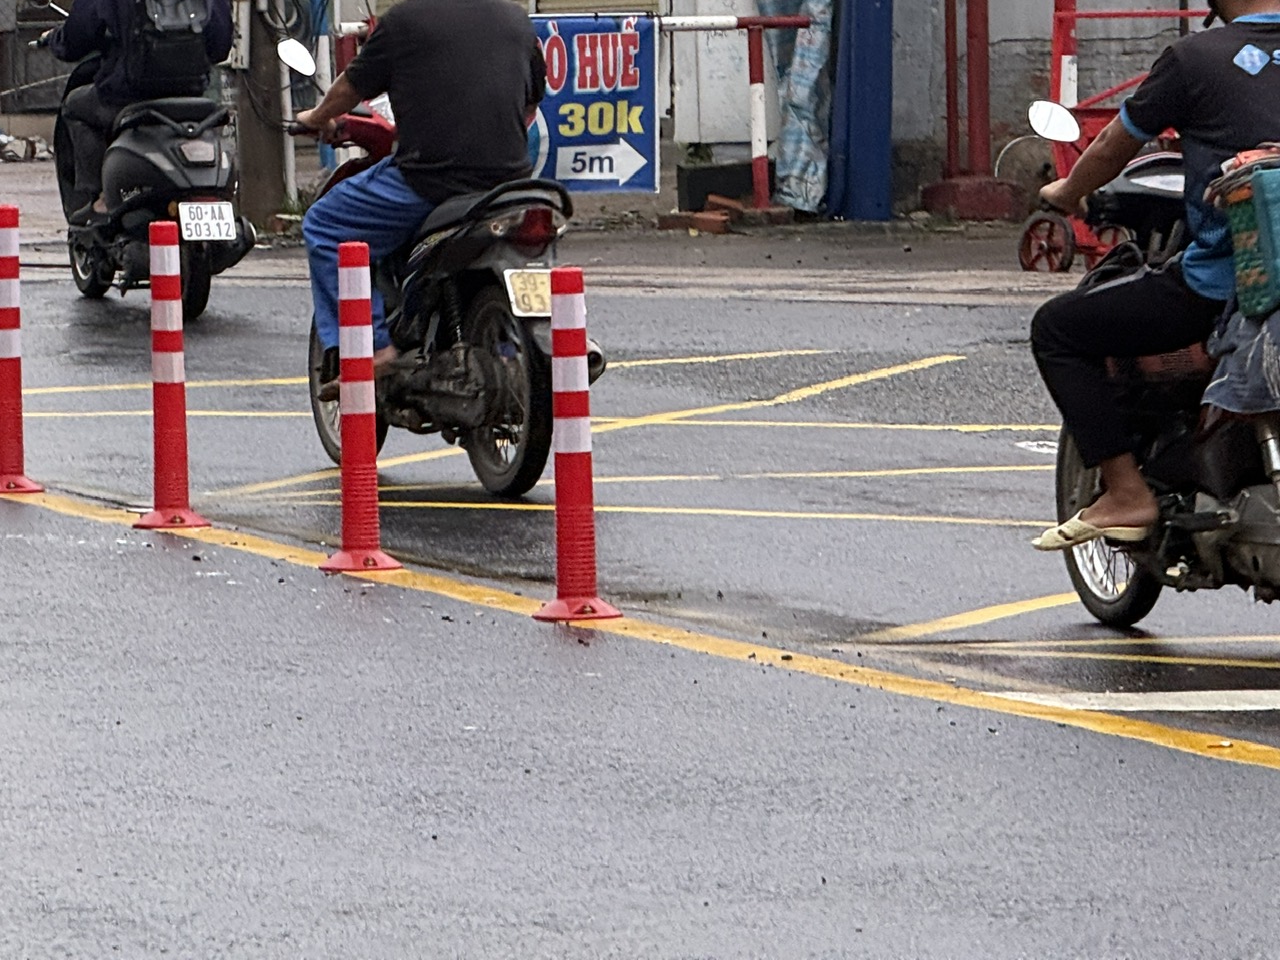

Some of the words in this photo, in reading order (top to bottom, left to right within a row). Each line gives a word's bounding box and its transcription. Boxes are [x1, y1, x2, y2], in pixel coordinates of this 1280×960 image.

[537, 20, 568, 92] Ò
[576, 17, 640, 91] HUẾ
[558, 100, 644, 137] 30k
[571, 152, 614, 173] 5m
[188, 205, 225, 221] 60-AA
[185, 222, 232, 238] 503.12
